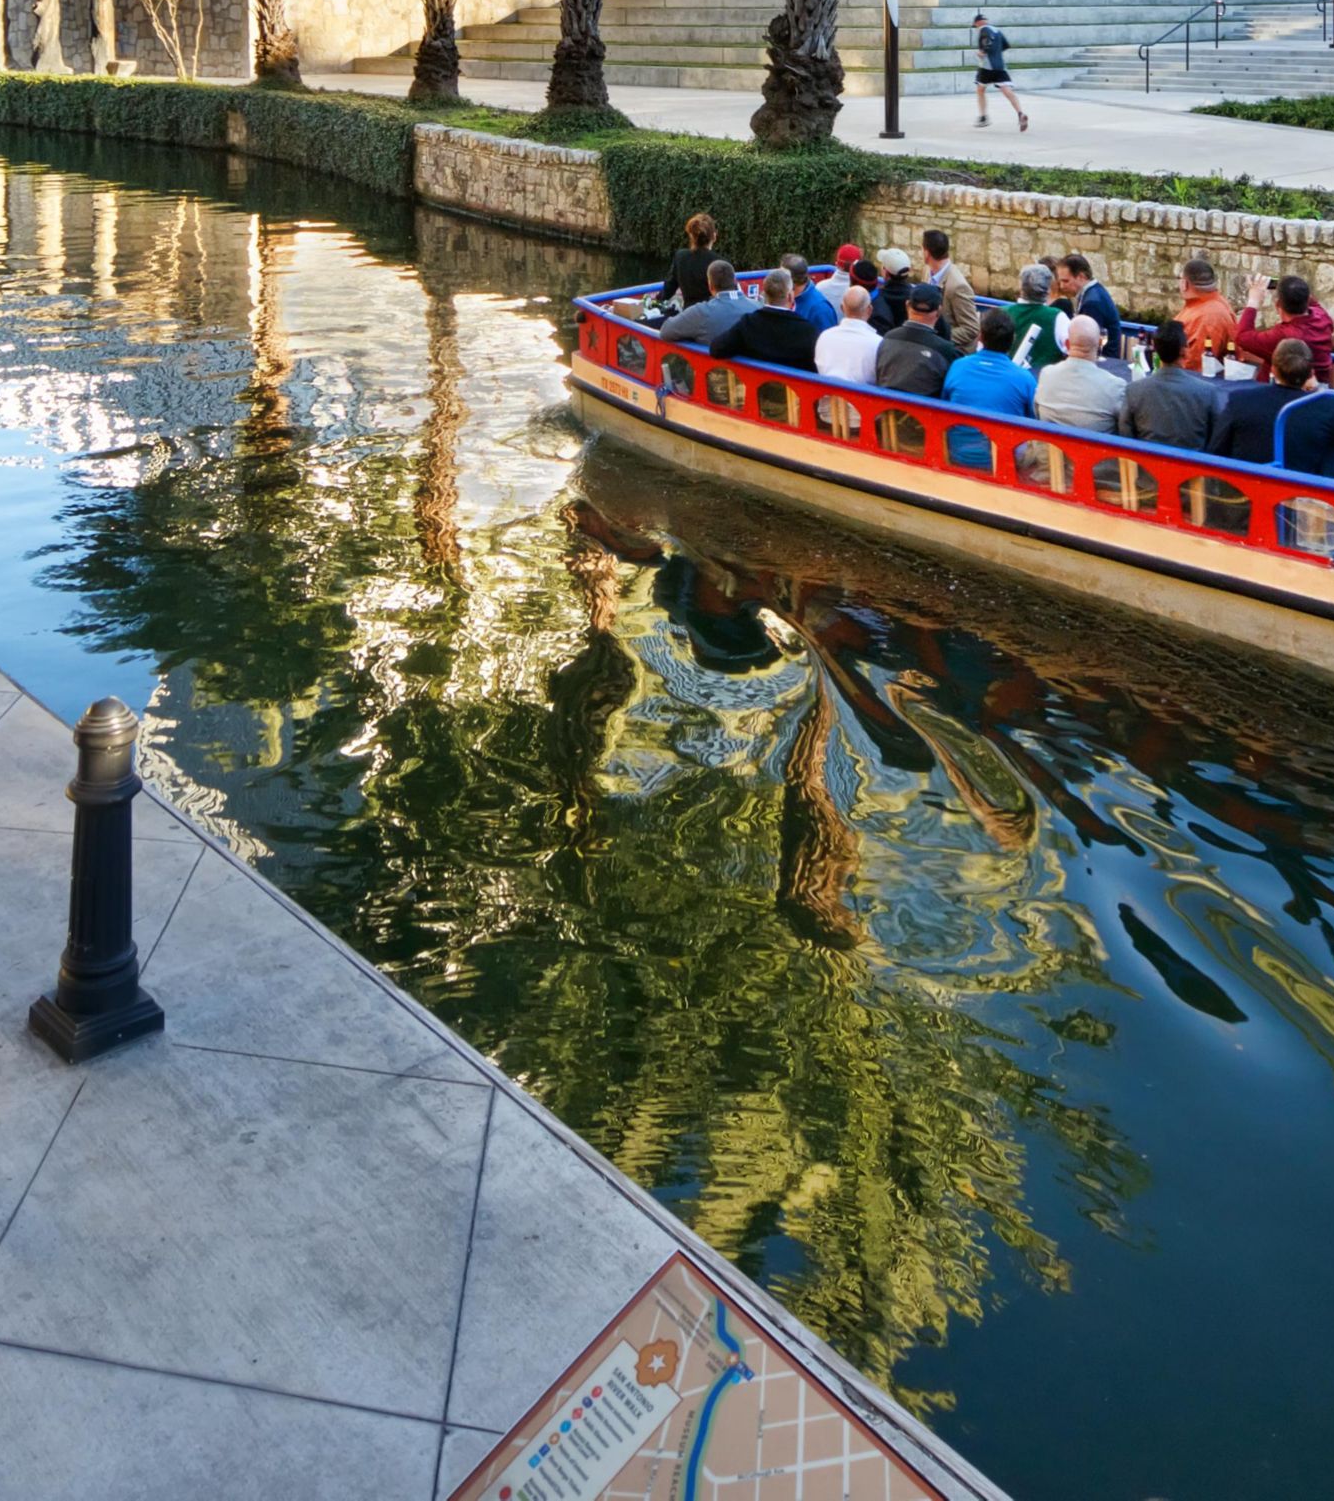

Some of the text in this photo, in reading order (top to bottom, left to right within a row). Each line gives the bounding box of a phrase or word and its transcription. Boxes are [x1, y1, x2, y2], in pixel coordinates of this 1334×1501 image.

[607, 1380, 643, 1419] RIVER WALK
[613, 1367, 654, 1412] SAN ANTONIO
[678, 1410, 695, 1458] MUSEUM
